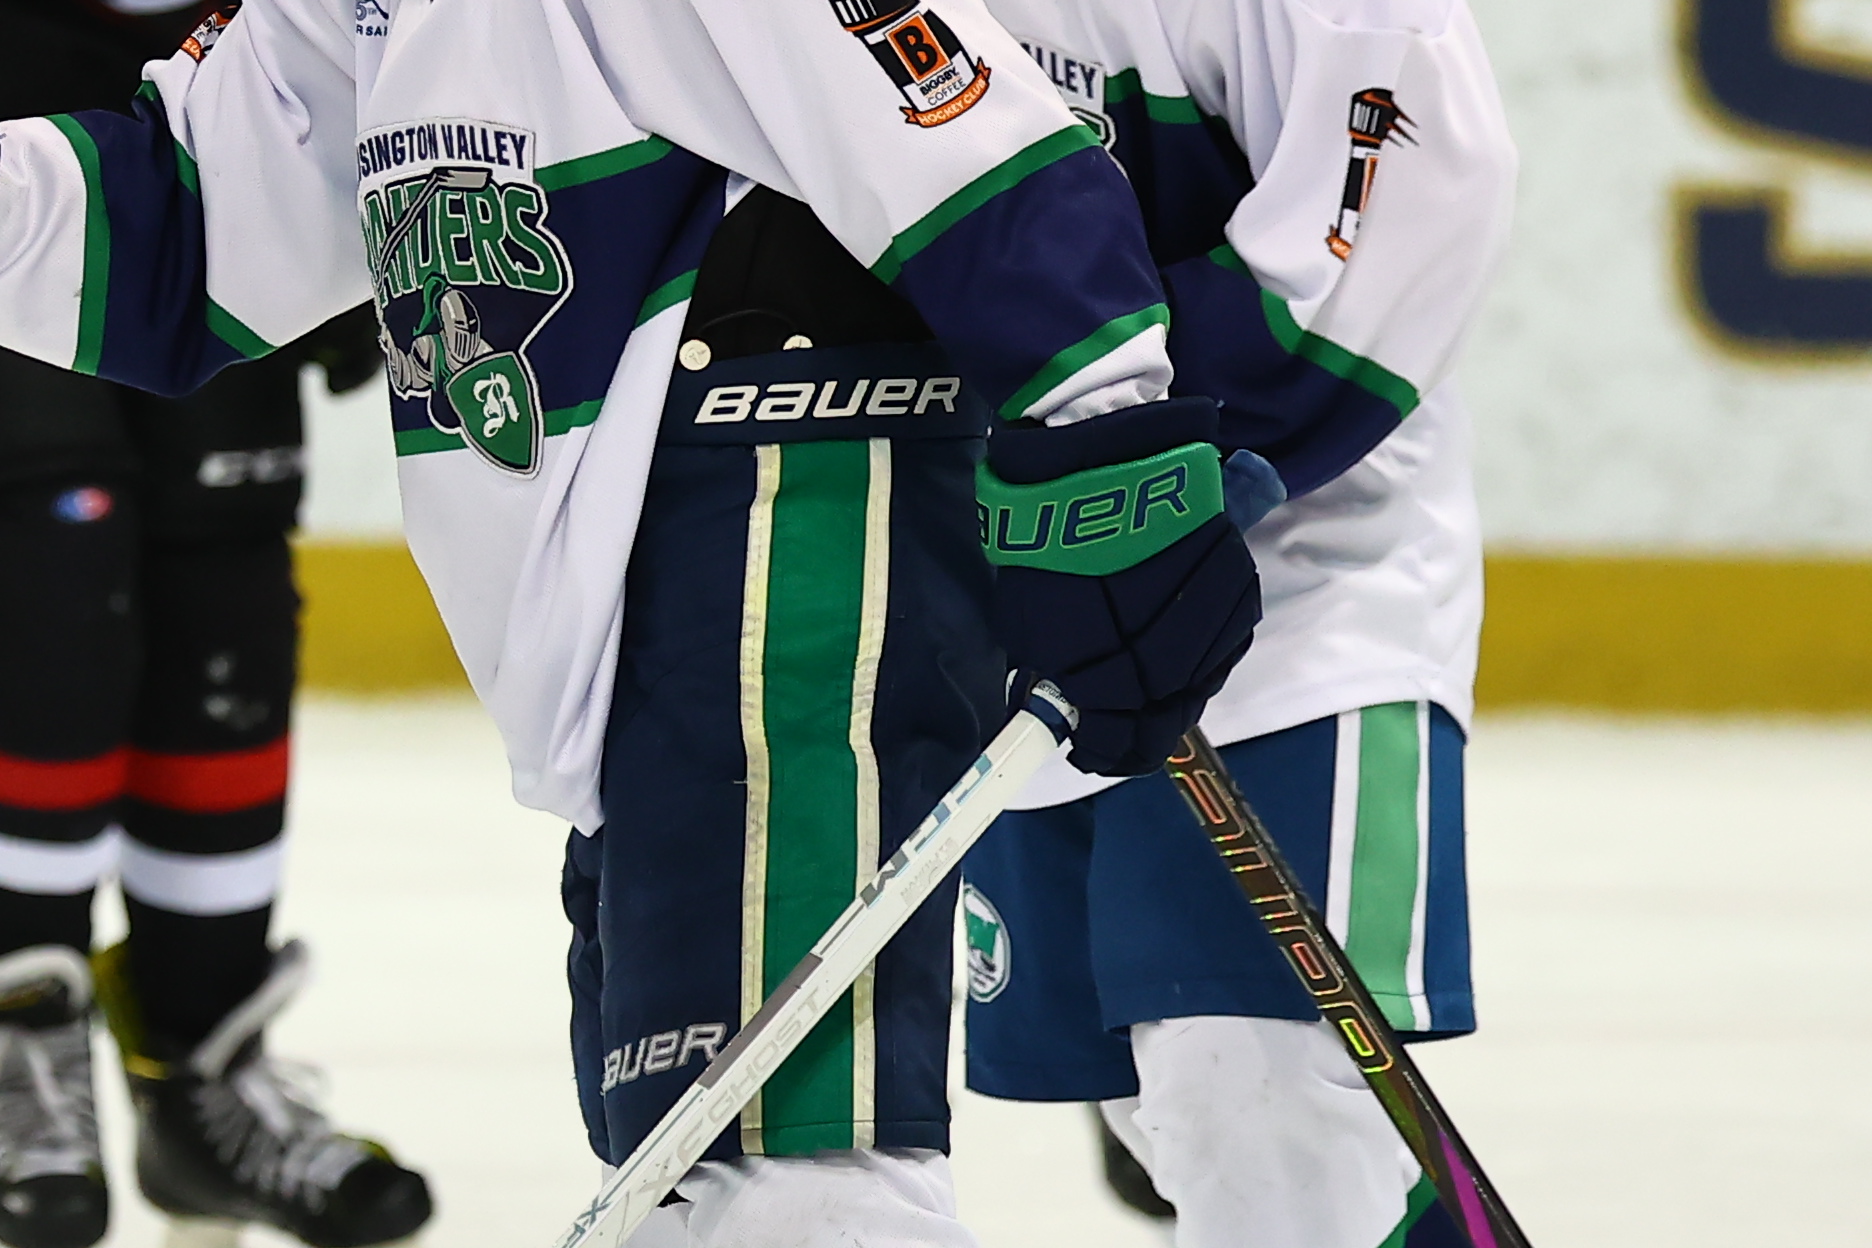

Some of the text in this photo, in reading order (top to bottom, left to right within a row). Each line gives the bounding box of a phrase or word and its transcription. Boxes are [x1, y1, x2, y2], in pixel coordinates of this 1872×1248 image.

[895, 25, 939, 77] B
[1020, 42, 1097, 100] LLEY
[918, 65, 960, 98] BIGGBY
[918, 76, 989, 126] HOCKEY CLUB
[927, 78, 967, 106] COFFEE
[357, 123, 527, 179] SINGTON VALLEY
[362, 181, 563, 307] AIDERS
[694, 377, 960, 424] BAUER
[707, 986, 826, 1125] GHOST
